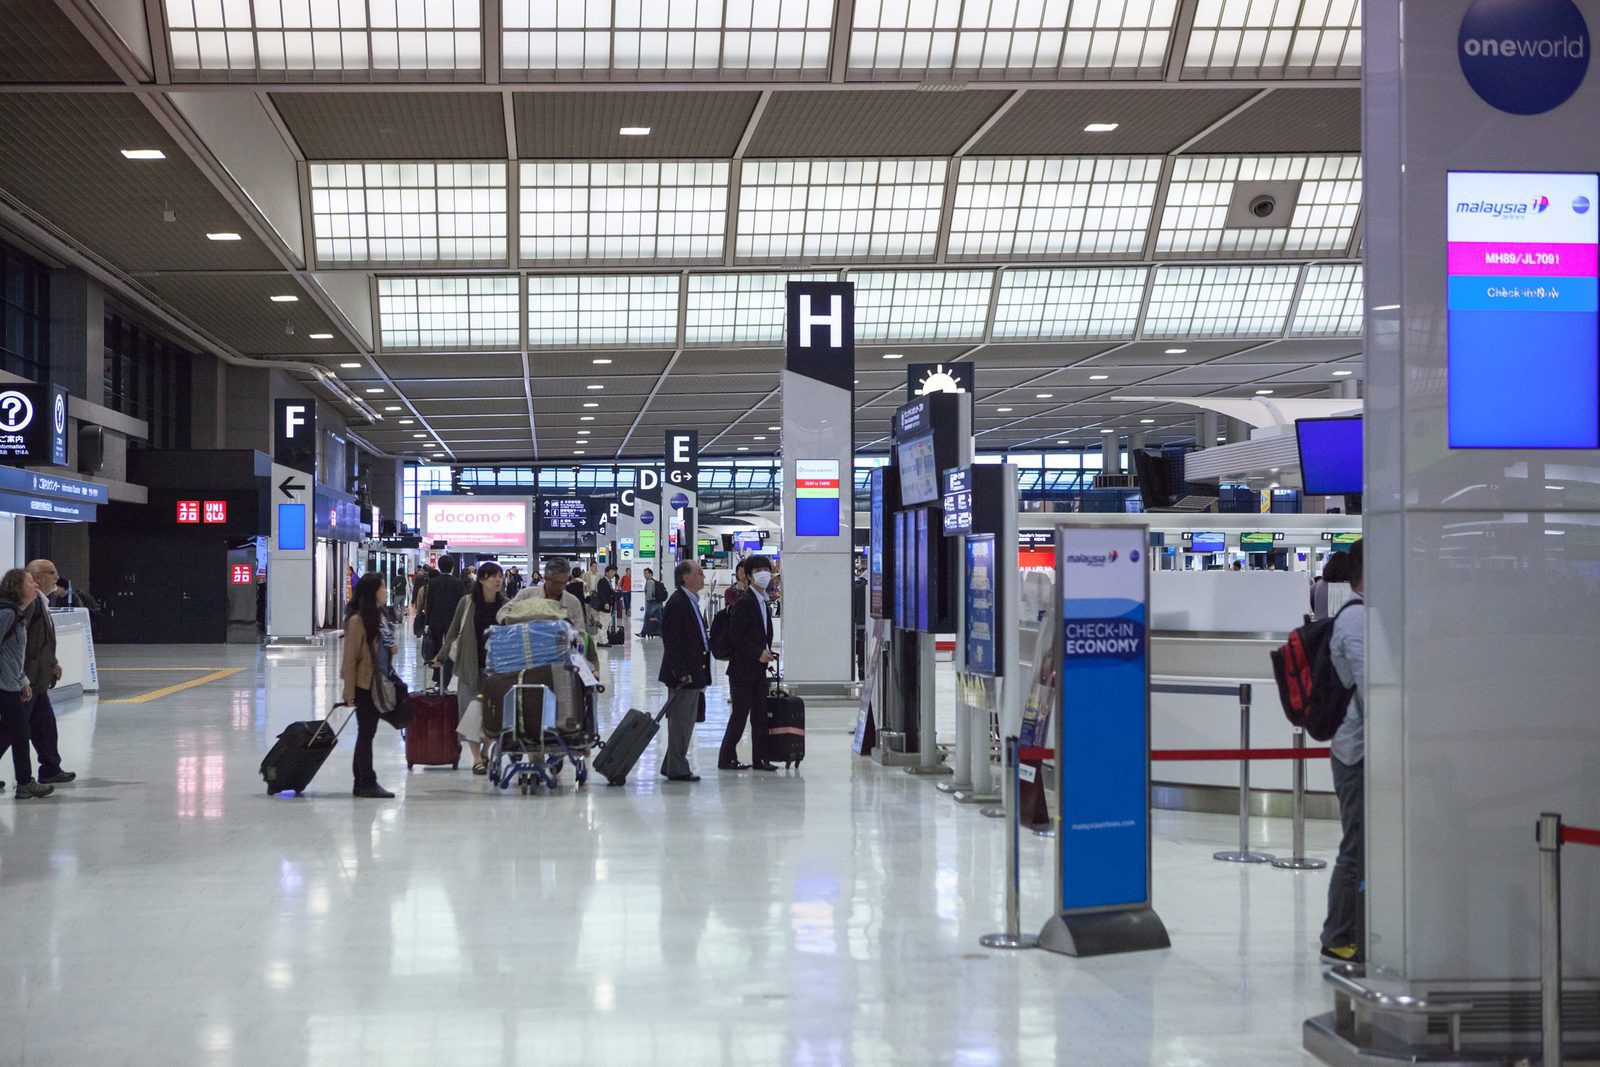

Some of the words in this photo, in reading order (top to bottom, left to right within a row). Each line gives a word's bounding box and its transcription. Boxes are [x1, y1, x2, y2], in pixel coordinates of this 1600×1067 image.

[1464, 35, 1584, 58] oneworld
[1456, 200, 1527, 217] malaysia
[1485, 252, 1560, 265] MH89/JL7091
[799, 294, 842, 348] H
[285, 405, 306, 438] F
[673, 435, 690, 463] E
[639, 469, 658, 490] D
[670, 470, 682, 483] G
[621, 489, 634, 506] C
[434, 510, 501, 523] docomo
[599, 512, 608, 525] A
[609, 503, 619, 518] B
[1066, 623, 1134, 638] CHECK-IN
[1066, 638, 1139, 654] ECONOMY
